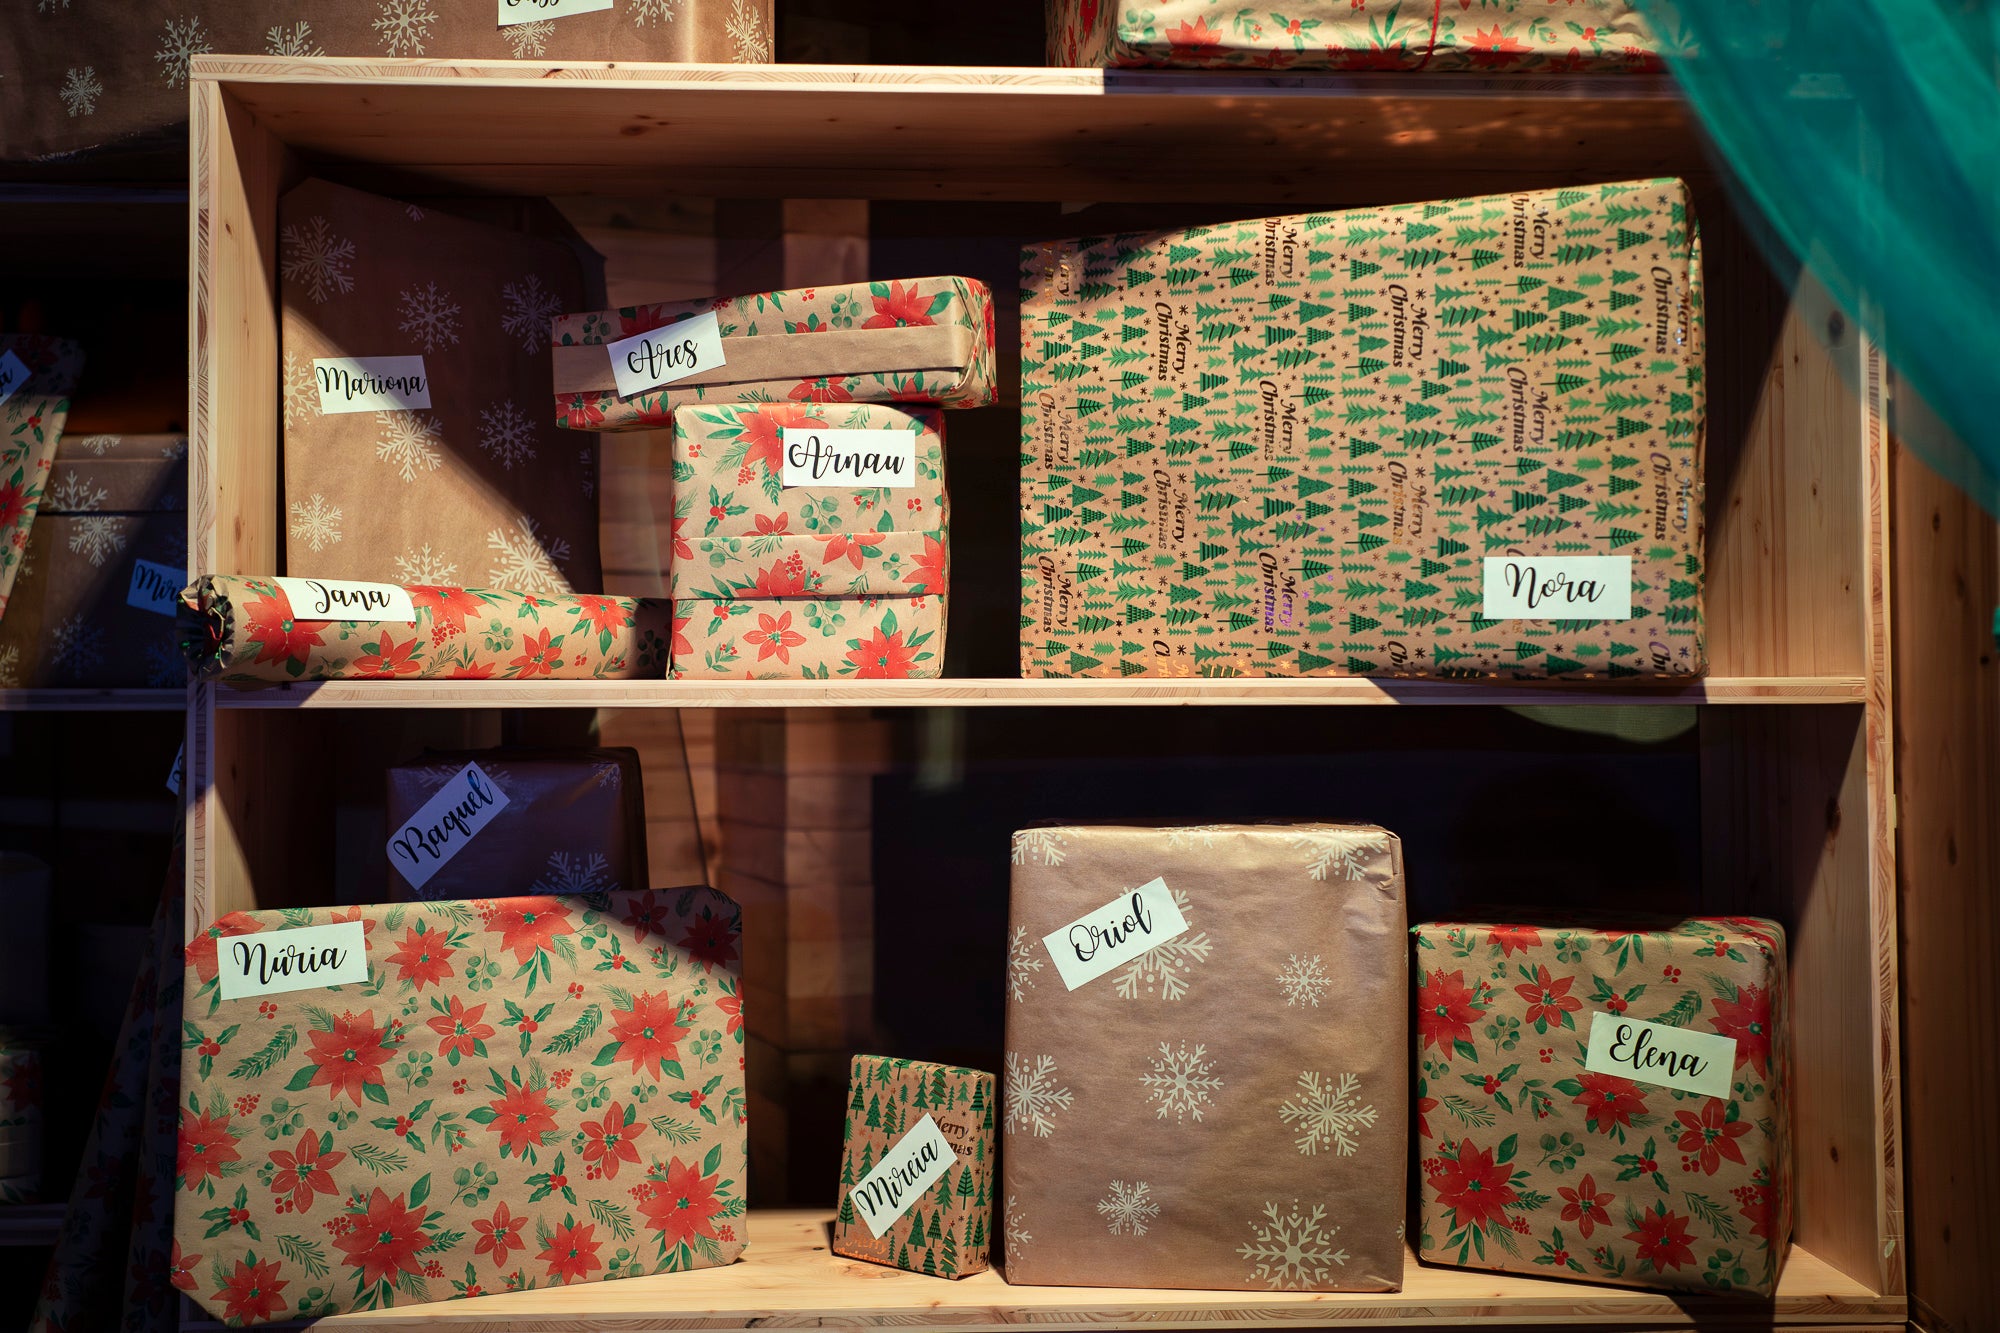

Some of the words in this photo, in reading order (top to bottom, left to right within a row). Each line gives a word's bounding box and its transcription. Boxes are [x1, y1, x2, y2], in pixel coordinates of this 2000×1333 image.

[1279, 225, 1299, 279] Merry
[1530, 203, 1552, 260] Merry
[1388, 284, 1408, 368] Christmas
[1408, 302, 1429, 360] Merry
[1651, 266, 1673, 354] Christmas
[627, 338, 699, 380] Ares
[1154, 301, 1172, 382] Christmas
[1173, 319, 1193, 375] Merry
[316, 365, 426, 400] Mariona
[1507, 367, 1528, 454] Christmas
[1039, 391, 1056, 470] Christmas
[1058, 410, 1074, 465] Merry
[1259, 379, 1277, 463] Christmas
[1279, 398, 1299, 455] Merry
[1530, 386, 1551, 447] Merry
[789, 435, 905, 480] Arnau
[1153, 469, 1172, 551] Christmas
[1173, 487, 1192, 545] Merry
[1388, 461, 1407, 546] Christmas
[1408, 476, 1429, 539] Merry
[1650, 452, 1672, 542] Christmas
[135, 565, 183, 603] Mir
[306, 580, 391, 614] Jana
[1038, 555, 1056, 634] Christmas
[1057, 573, 1075, 628] Merry
[1259, 551, 1278, 634] Christmas
[1279, 570, 1299, 628] Merry
[1504, 562, 1606, 609] Nora
[393, 769, 494, 864] Raquel
[1069, 892, 1152, 962] Oriol
[233, 941, 347, 986] Núria
[1609, 1024, 1709, 1077] Elena
[855, 1138, 938, 1216] Mireia
